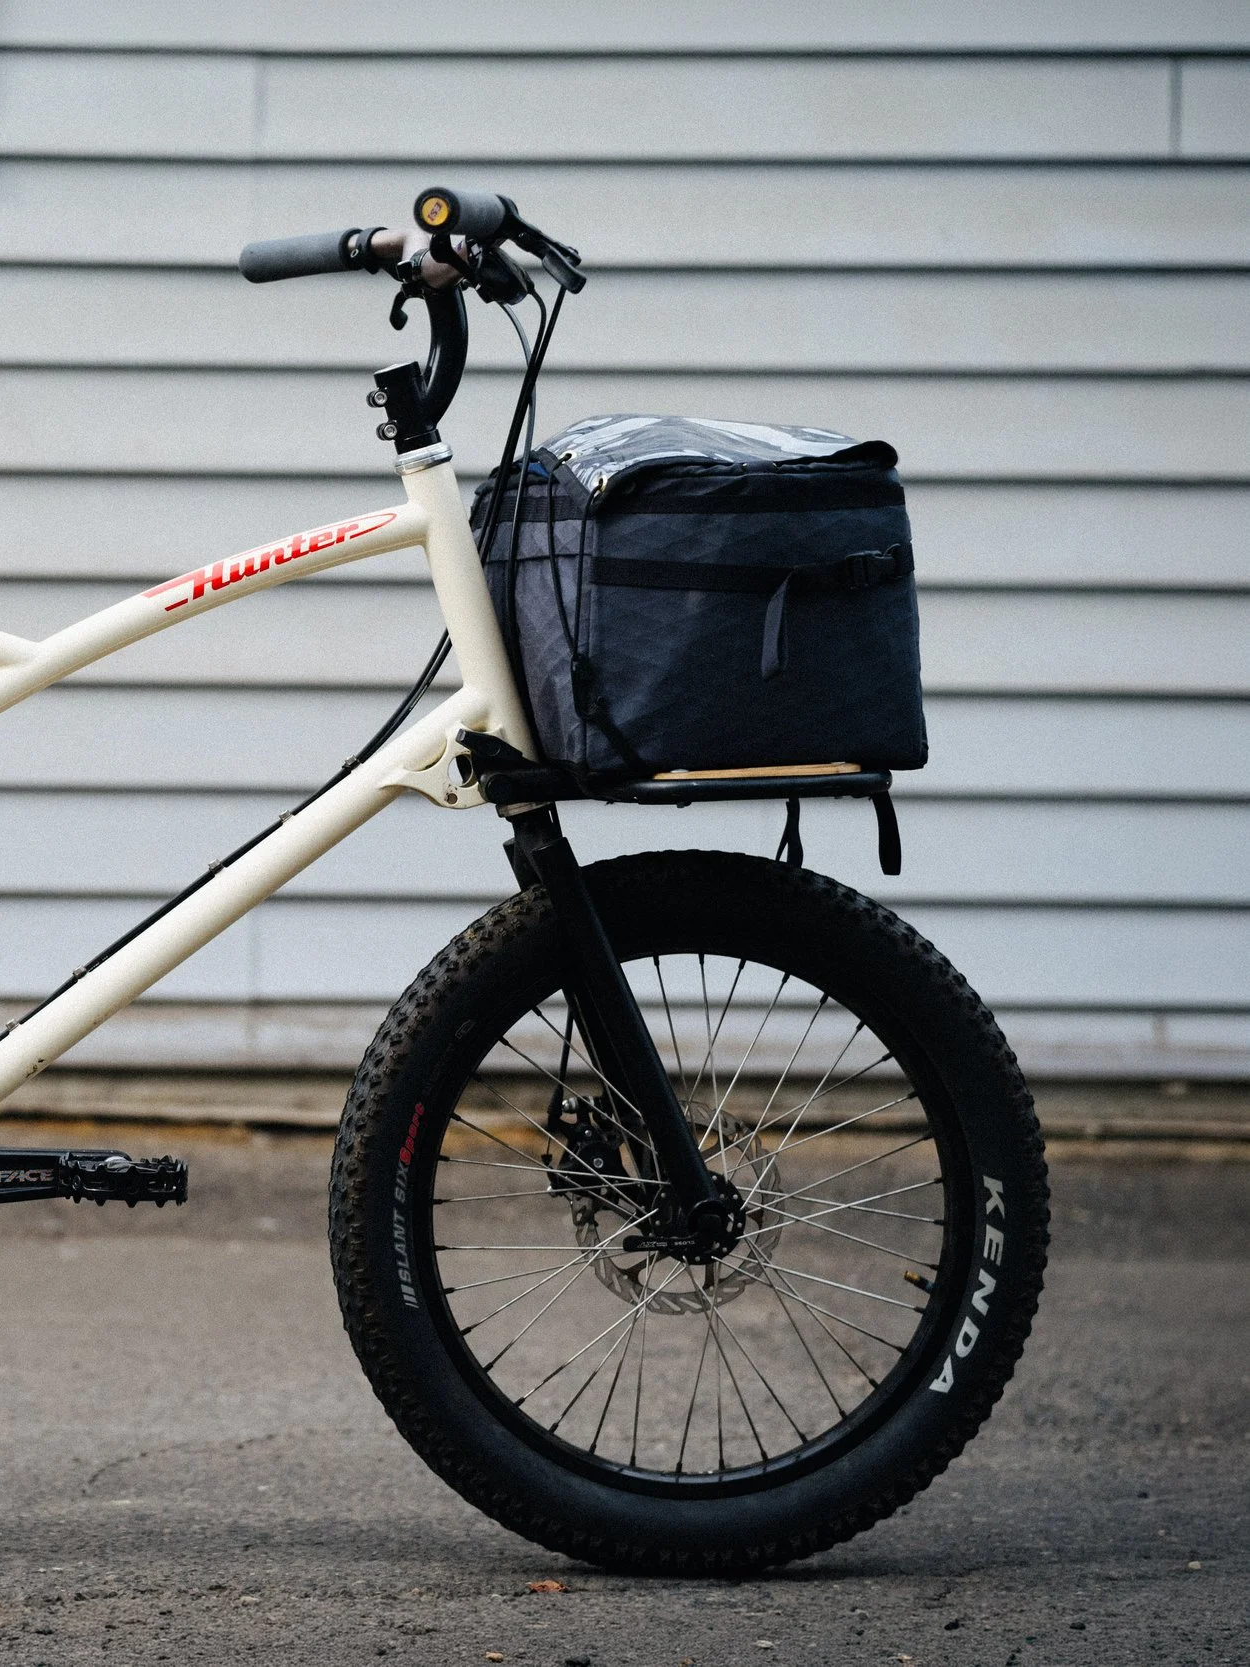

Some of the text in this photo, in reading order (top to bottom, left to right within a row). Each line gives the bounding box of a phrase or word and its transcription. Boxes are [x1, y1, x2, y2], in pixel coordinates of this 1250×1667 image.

[141, 521, 361, 601] Hunter
[393, 1102, 425, 1282] SLANT SIX Sport
[929, 1175, 1006, 1393] KENDA
